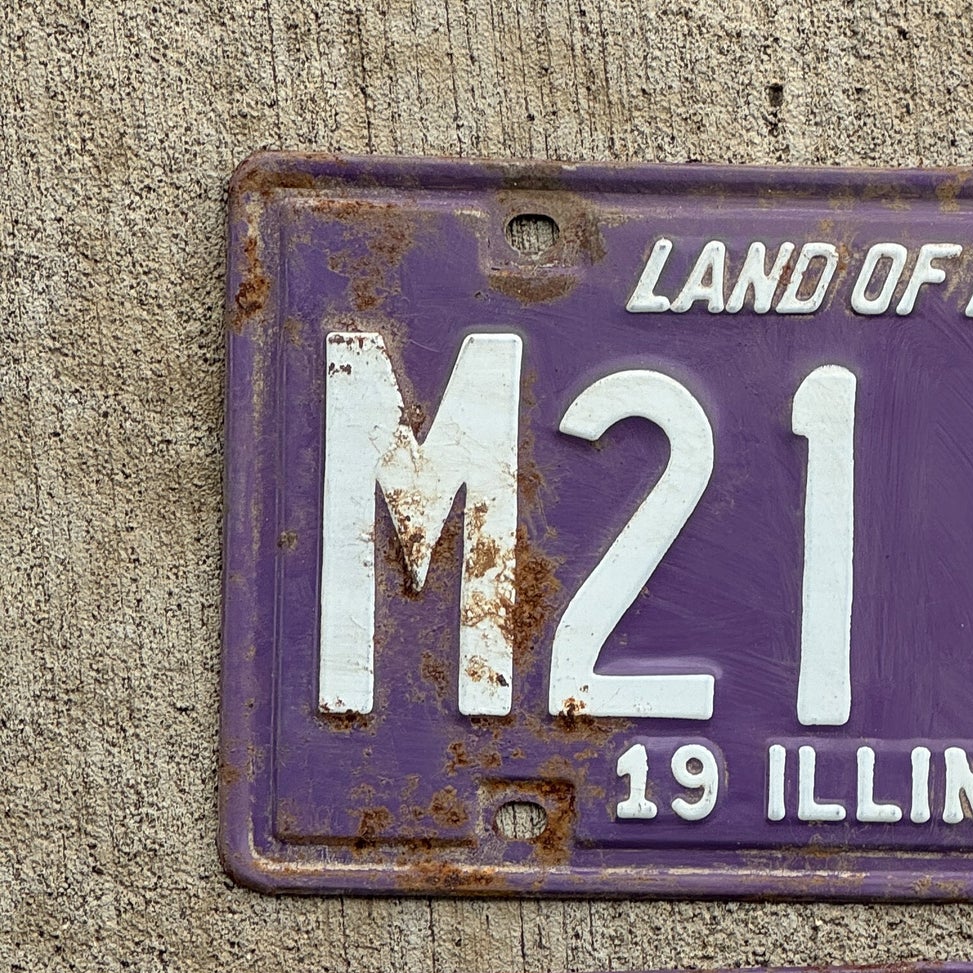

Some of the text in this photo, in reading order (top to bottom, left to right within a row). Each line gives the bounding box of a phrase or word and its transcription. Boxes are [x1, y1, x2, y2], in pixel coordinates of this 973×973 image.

[625, 238, 840, 314] LAND
[849, 242, 963, 316] OF
[318, 331, 858, 727] M21
[615, 743, 720, 821] 19
